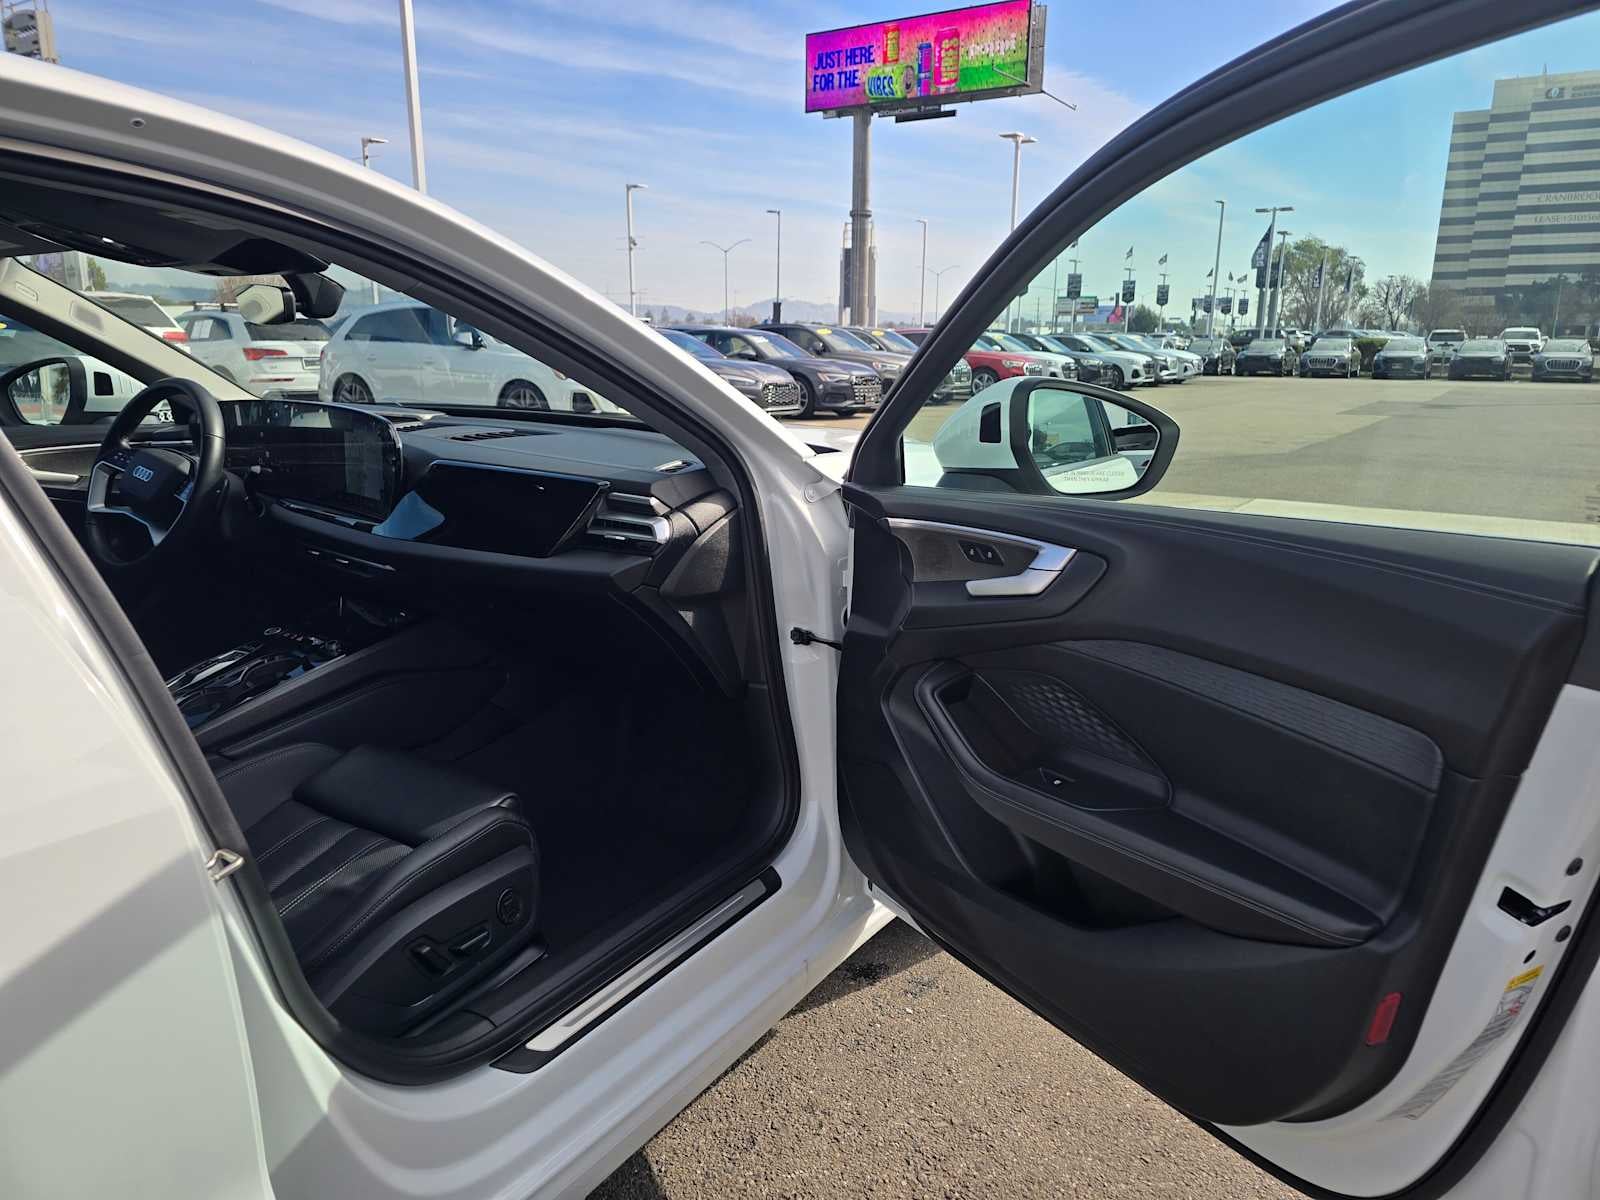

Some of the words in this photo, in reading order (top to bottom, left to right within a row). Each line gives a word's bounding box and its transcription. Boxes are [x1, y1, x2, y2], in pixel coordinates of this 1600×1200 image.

[814, 50, 842, 70] JUST
[845, 45, 875, 66] HERE
[813, 72, 834, 92] FOR
[837, 69, 860, 88] THE
[867, 75, 895, 97] VIBES
